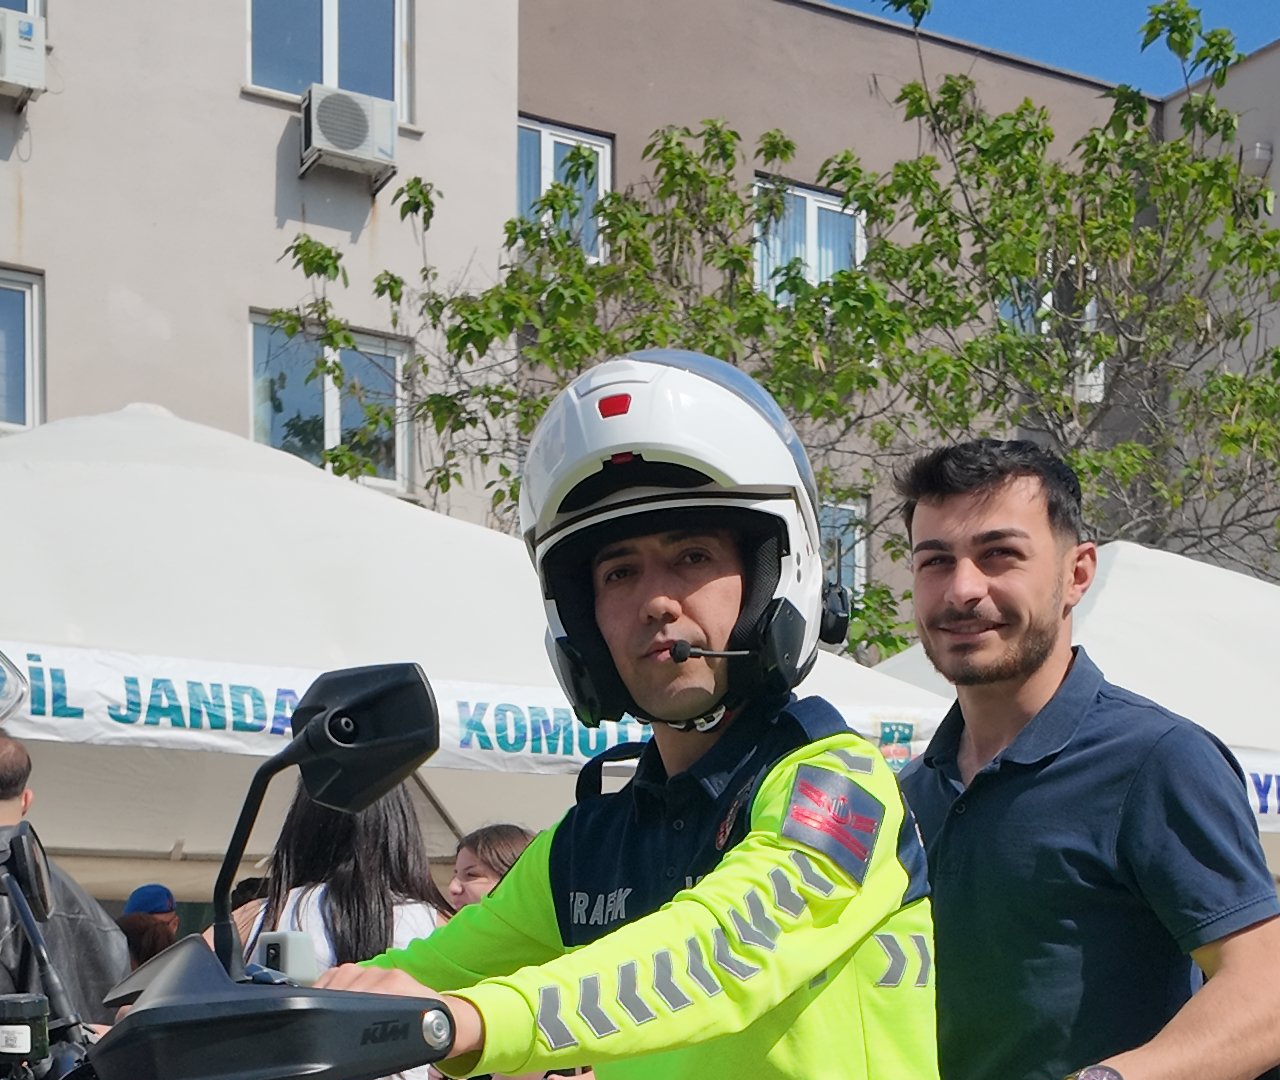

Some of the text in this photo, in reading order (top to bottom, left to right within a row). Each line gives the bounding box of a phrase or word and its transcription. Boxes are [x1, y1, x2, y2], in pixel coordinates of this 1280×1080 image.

[25, 653, 85, 720] İL
[107, 676, 301, 736] JANDA
[360, 1019, 411, 1047] KTM
